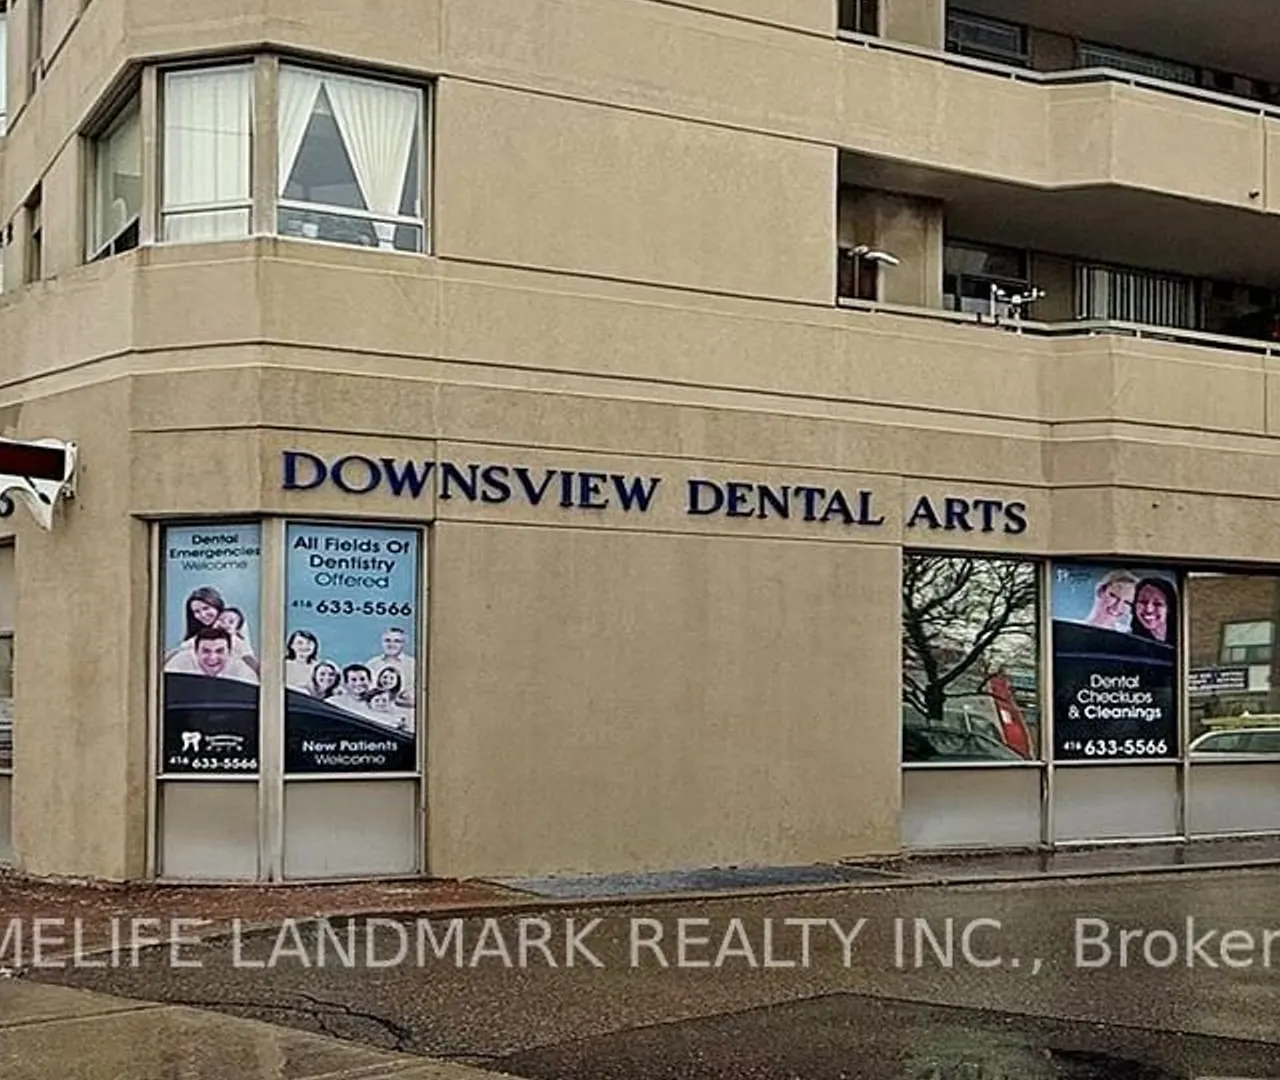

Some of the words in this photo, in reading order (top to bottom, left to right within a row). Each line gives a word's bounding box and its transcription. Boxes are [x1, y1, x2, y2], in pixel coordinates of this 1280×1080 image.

[281, 451, 662, 512] DOWNSVIEW
[687, 480, 885, 526] DENTAL
[907, 496, 1027, 534] ARTS
[192, 534, 238, 545] Dental
[294, 536, 318, 550] All
[325, 537, 380, 553] Fields
[386, 540, 410, 554] Of
[310, 554, 395, 573] Dentistry
[315, 572, 389, 588] Offered
[316, 600, 412, 616] 633-5566
[1090, 674, 1139, 688] Dental
[1077, 688, 1153, 704] Checkups
[1068, 704, 1080, 719] &
[1084, 704, 1162, 722] Cleanings
[302, 740, 337, 752] New
[339, 740, 398, 752] Patients
[1084, 739, 1168, 756] 633-5566
[192, 758, 258, 770] 633-5566
[315, 754, 386, 766] Welcome
